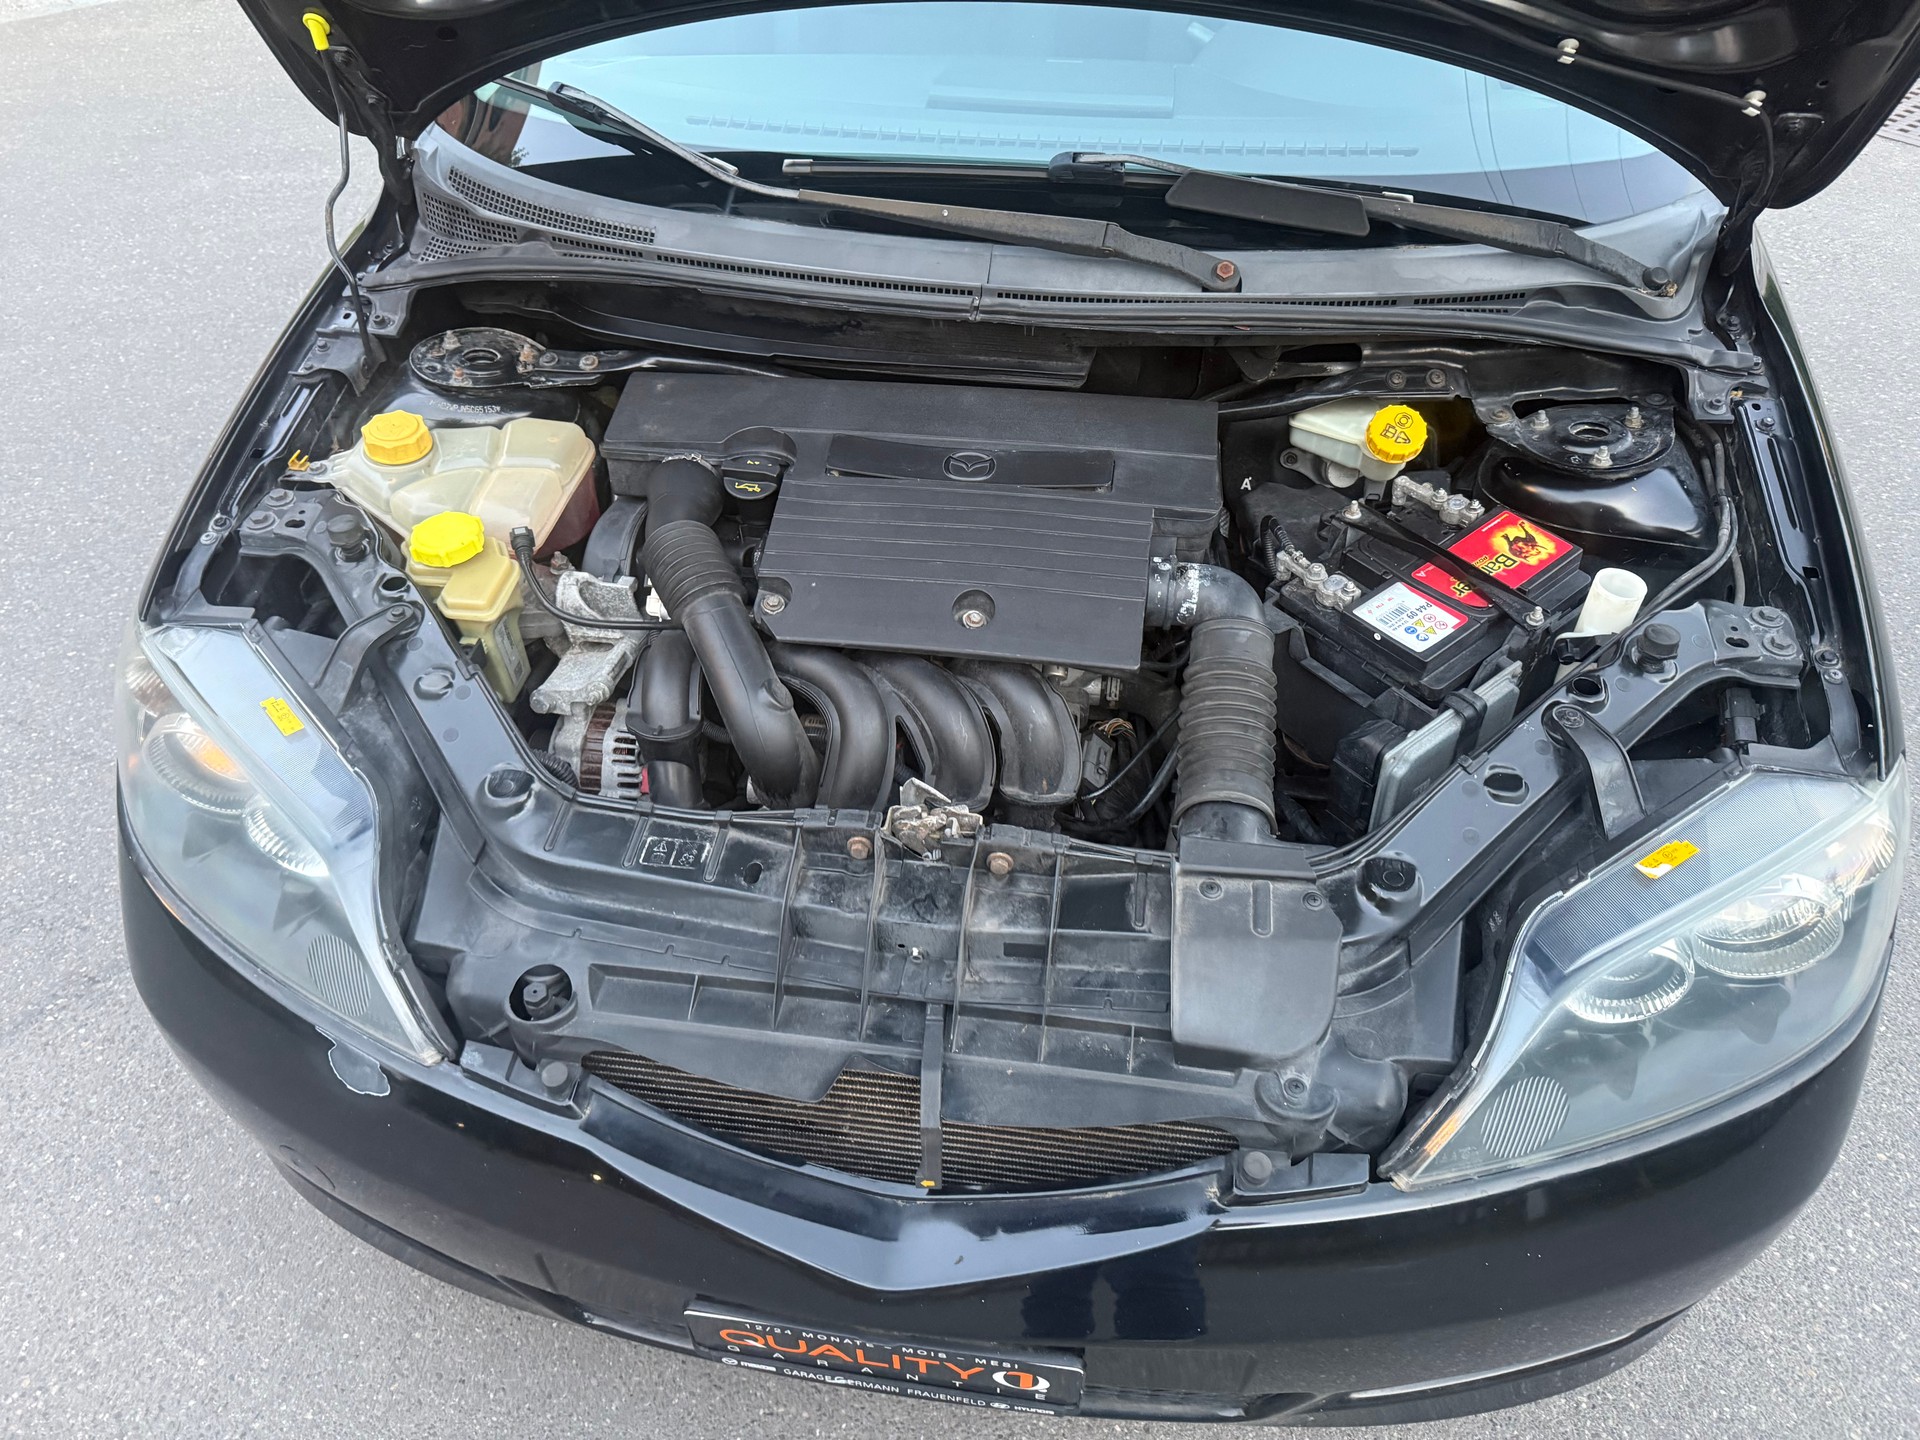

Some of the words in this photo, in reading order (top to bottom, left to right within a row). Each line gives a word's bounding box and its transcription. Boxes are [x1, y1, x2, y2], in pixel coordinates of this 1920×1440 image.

[719, 1329, 985, 1380] QUALITY
[745, 1323, 792, 1335] 12/24
[802, 1331, 875, 1348] MONATE
[902, 1347, 947, 1359] MOIS
[975, 1358, 1019, 1369] MESI
[783, 1368, 832, 1383] GARAGE
[907, 1388, 986, 1407] FRAUENFELD
